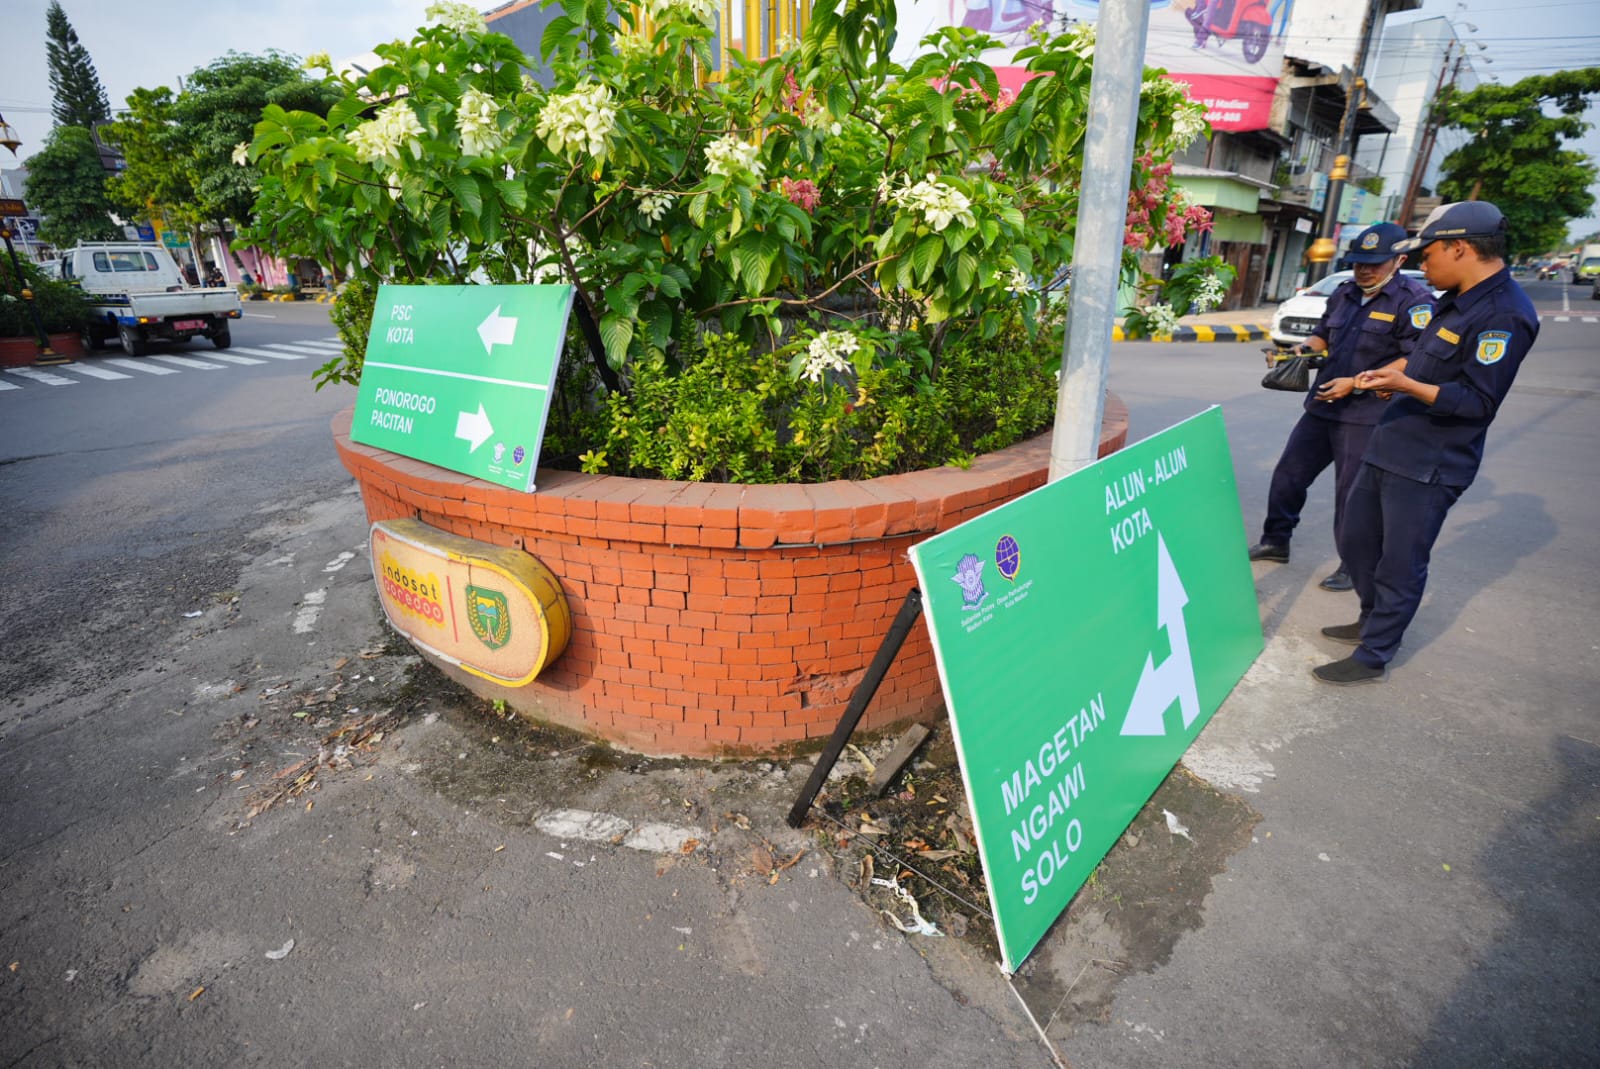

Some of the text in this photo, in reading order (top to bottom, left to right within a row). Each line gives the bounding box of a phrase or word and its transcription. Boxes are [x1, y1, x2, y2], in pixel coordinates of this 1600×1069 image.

[391, 304, 412, 321] PSC
[386, 327, 414, 344] KOTA
[370, 409, 414, 434] PACITAN
[375, 387, 436, 415] PONOROGO
[1105, 471, 1146, 515] ALUN
[1155, 445, 1188, 484] ALUN
[1110, 507, 1153, 555] KOTA
[382, 562, 437, 600] indosat
[1001, 692, 1107, 816] MAGETAN
[1010, 762, 1086, 863] NGAWI
[1021, 818, 1082, 905] SOLO
